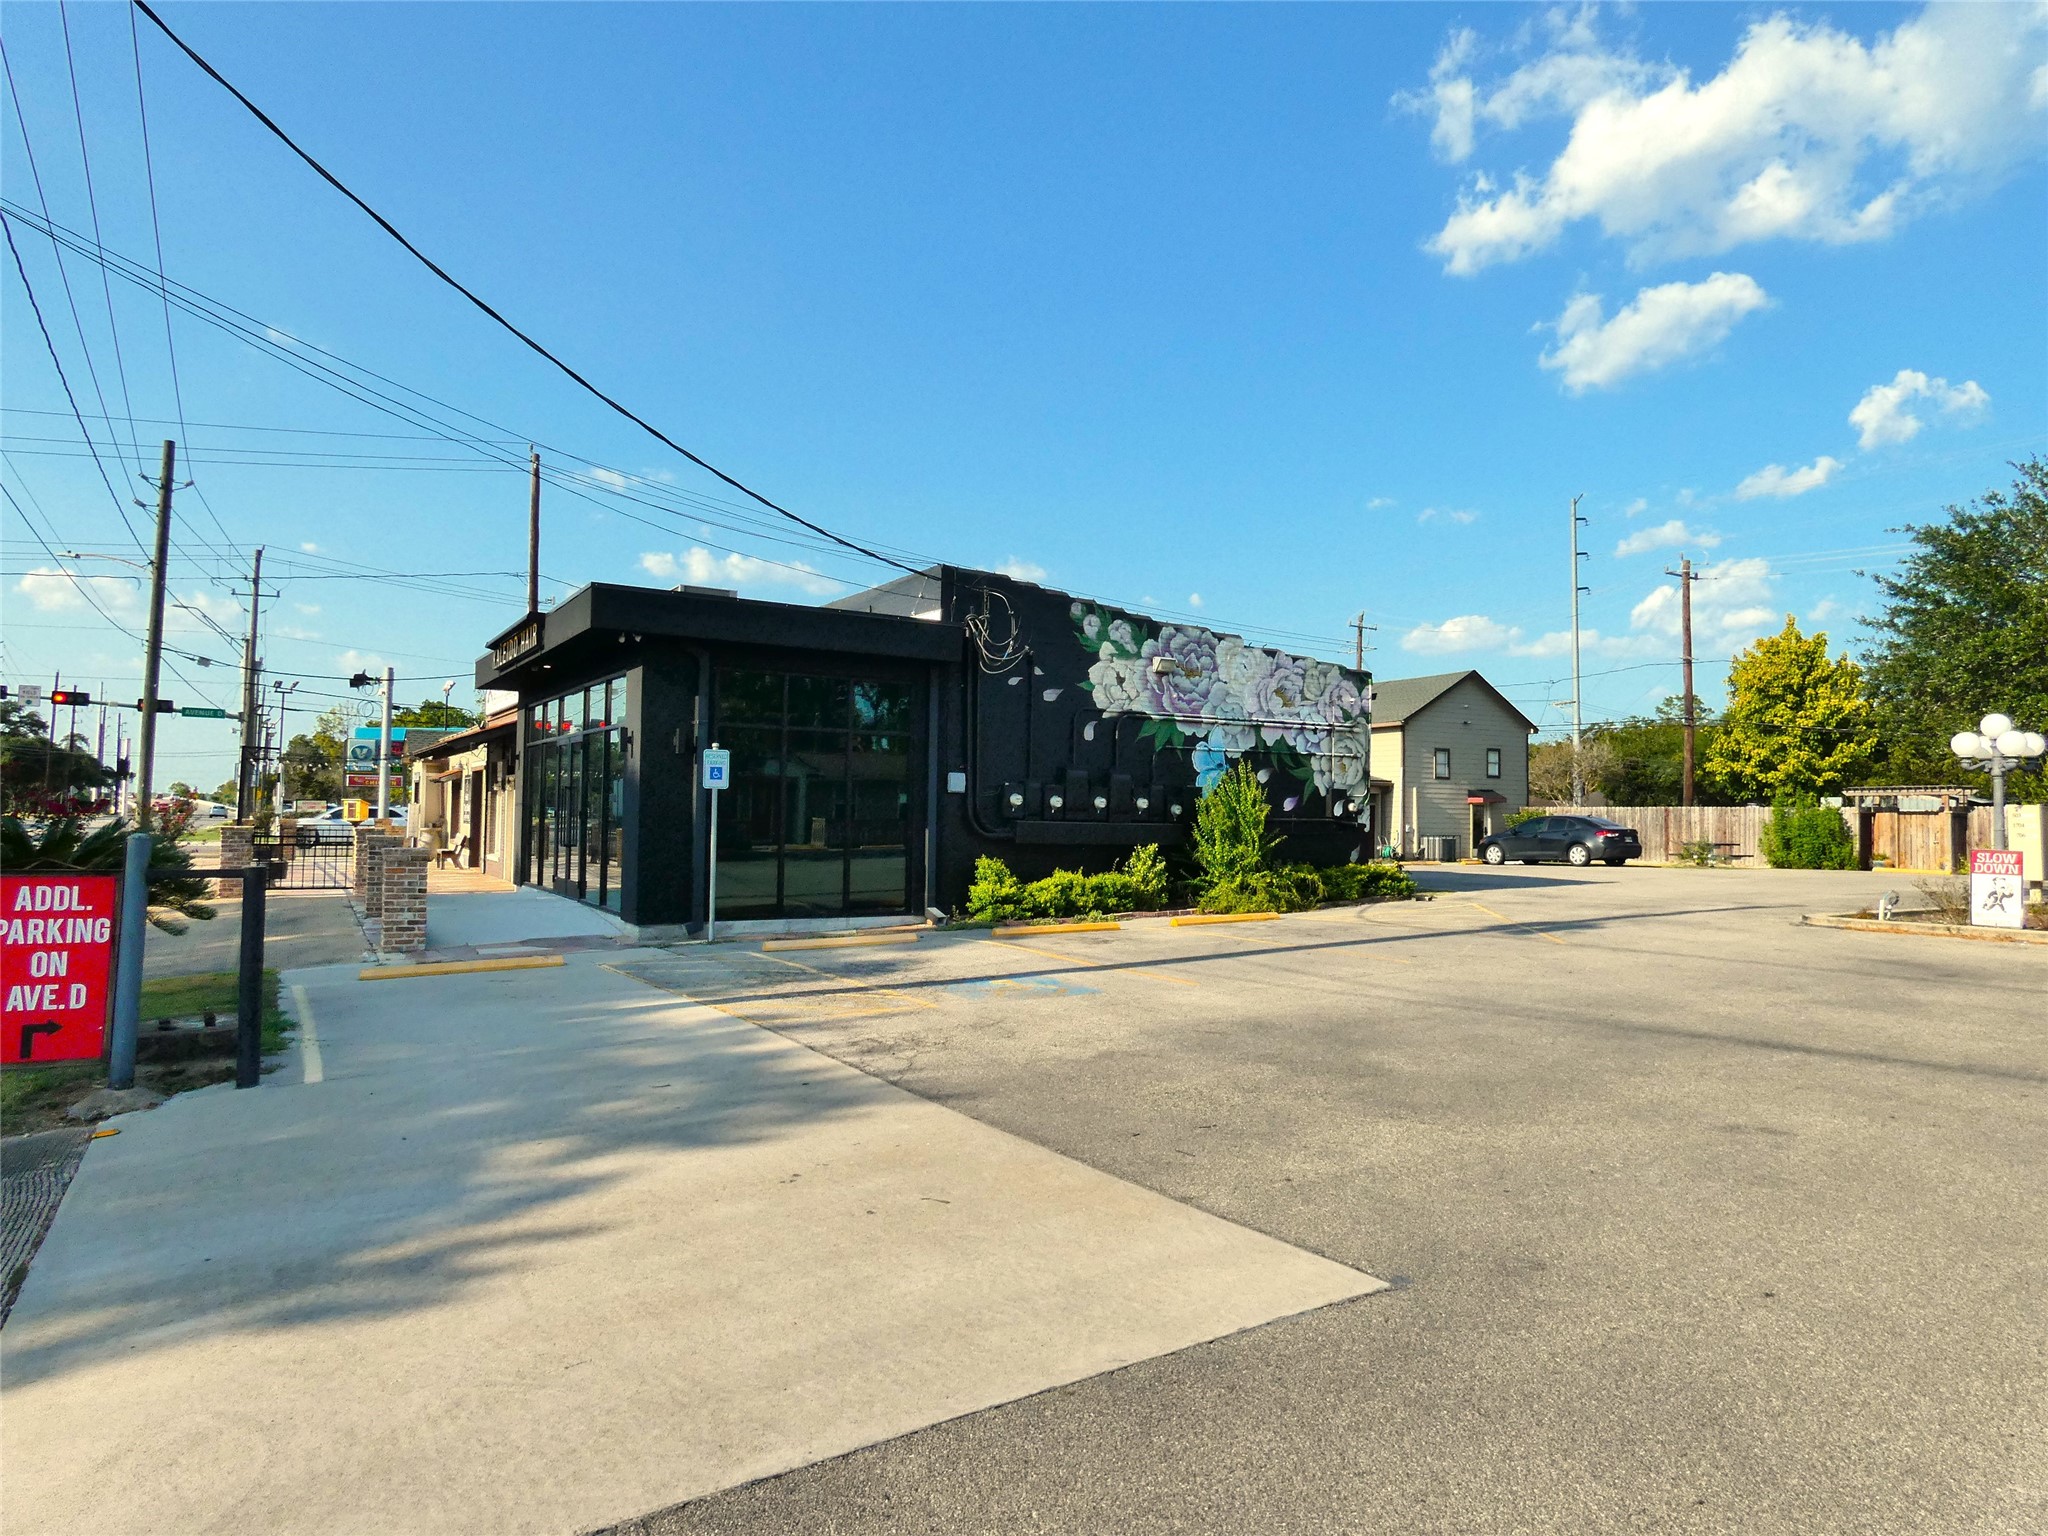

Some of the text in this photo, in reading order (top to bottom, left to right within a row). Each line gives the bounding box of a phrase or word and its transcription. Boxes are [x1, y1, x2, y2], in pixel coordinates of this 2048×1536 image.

[520, 622, 538, 654] HAIR
[185, 709, 215, 717] AVENUE
[1973, 862, 2020, 875] DOWN
[1976, 852, 2018, 864] SLOW
[14, 885, 94, 912] ADDL.
[0, 917, 111, 945] PARKING
[30, 951, 69, 978] ON
